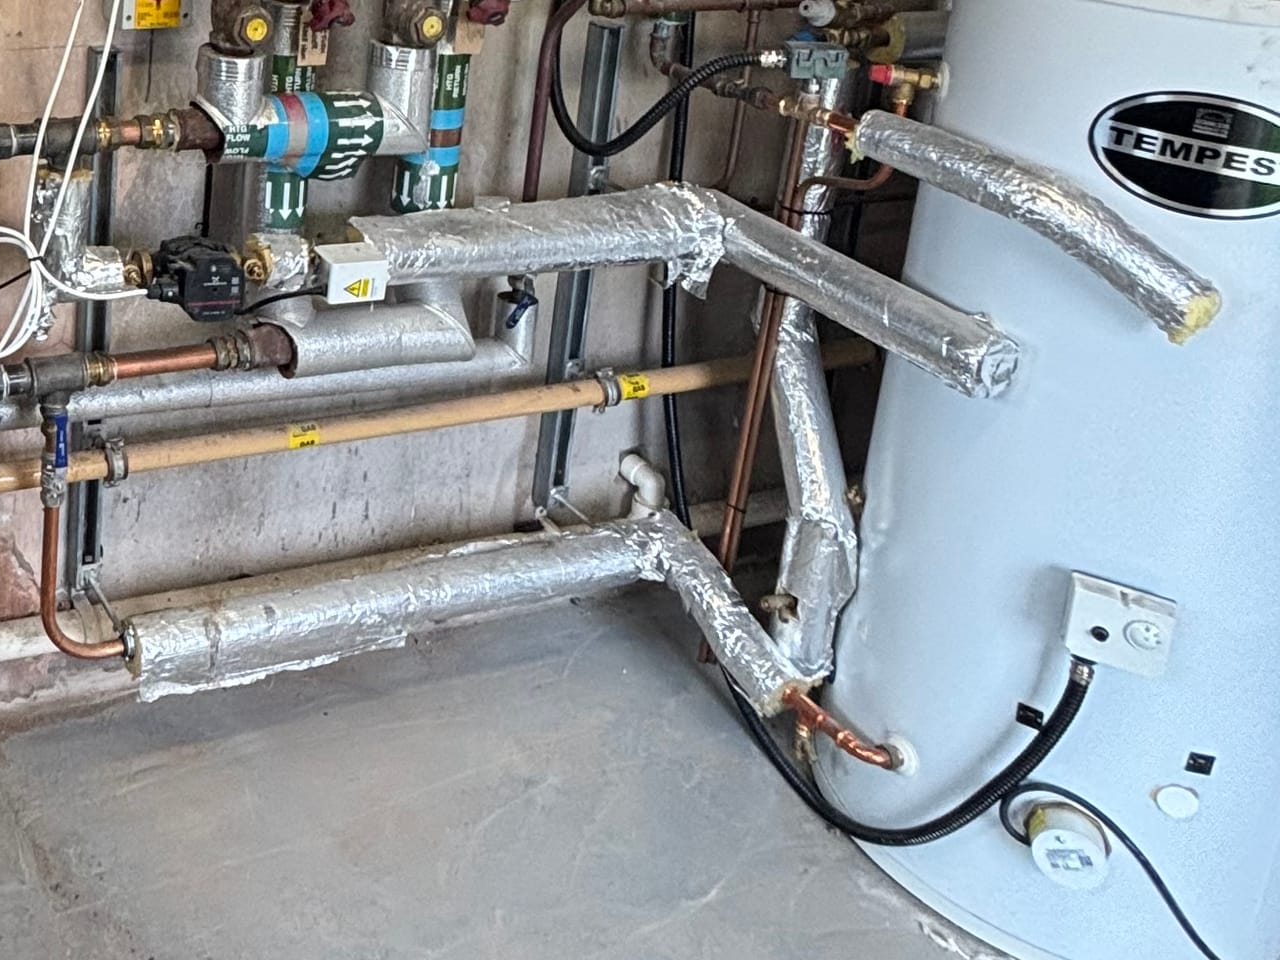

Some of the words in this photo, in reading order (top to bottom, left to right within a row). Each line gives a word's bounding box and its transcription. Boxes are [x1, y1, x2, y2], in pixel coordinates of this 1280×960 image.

[446, 73, 454, 91] HTG
[229, 125, 248, 133] HTG
[226, 134, 251, 142] FLOW
[1108, 125, 1280, 176] TEMPES
